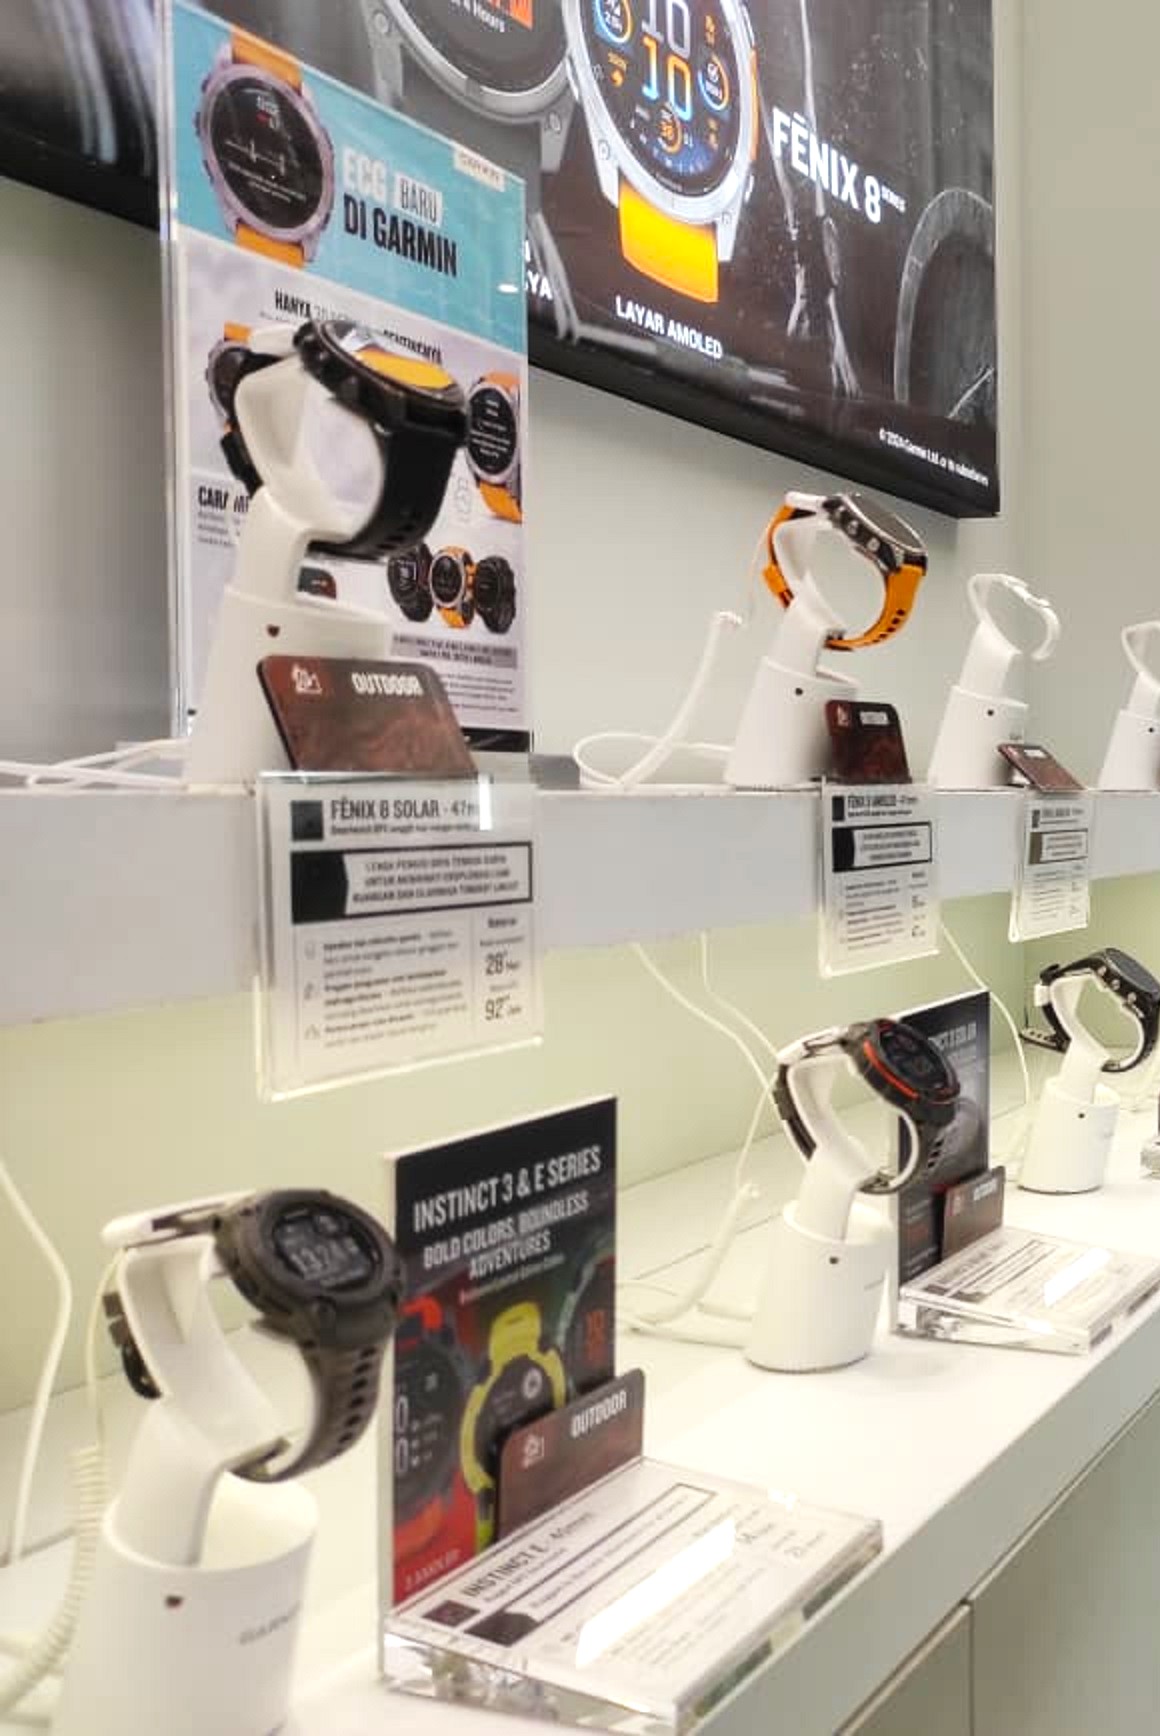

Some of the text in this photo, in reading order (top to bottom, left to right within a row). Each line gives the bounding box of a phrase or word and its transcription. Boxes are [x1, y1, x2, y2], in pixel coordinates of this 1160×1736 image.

[641, 36, 693, 121] 10
[343, 151, 438, 224] ECG BARU
[864, 175, 881, 223] 8
[343, 193, 457, 278] DI GARMIN
[275, 289, 311, 318] HANYA
[615, 295, 724, 360] LAYAR AMOLED
[351, 672, 424, 697] OUTDOOR
[393, 798, 439, 819] SOLAR
[413, 1145, 601, 1233] INSTINCT 3 & E SERIES
[423, 1237, 461, 1270] BOLD
[519, 1190, 590, 1234] BOUNDLESS
[469, 1230, 551, 1281] ADVENTURES
[570, 1389, 627, 1439] OUTDOOR
